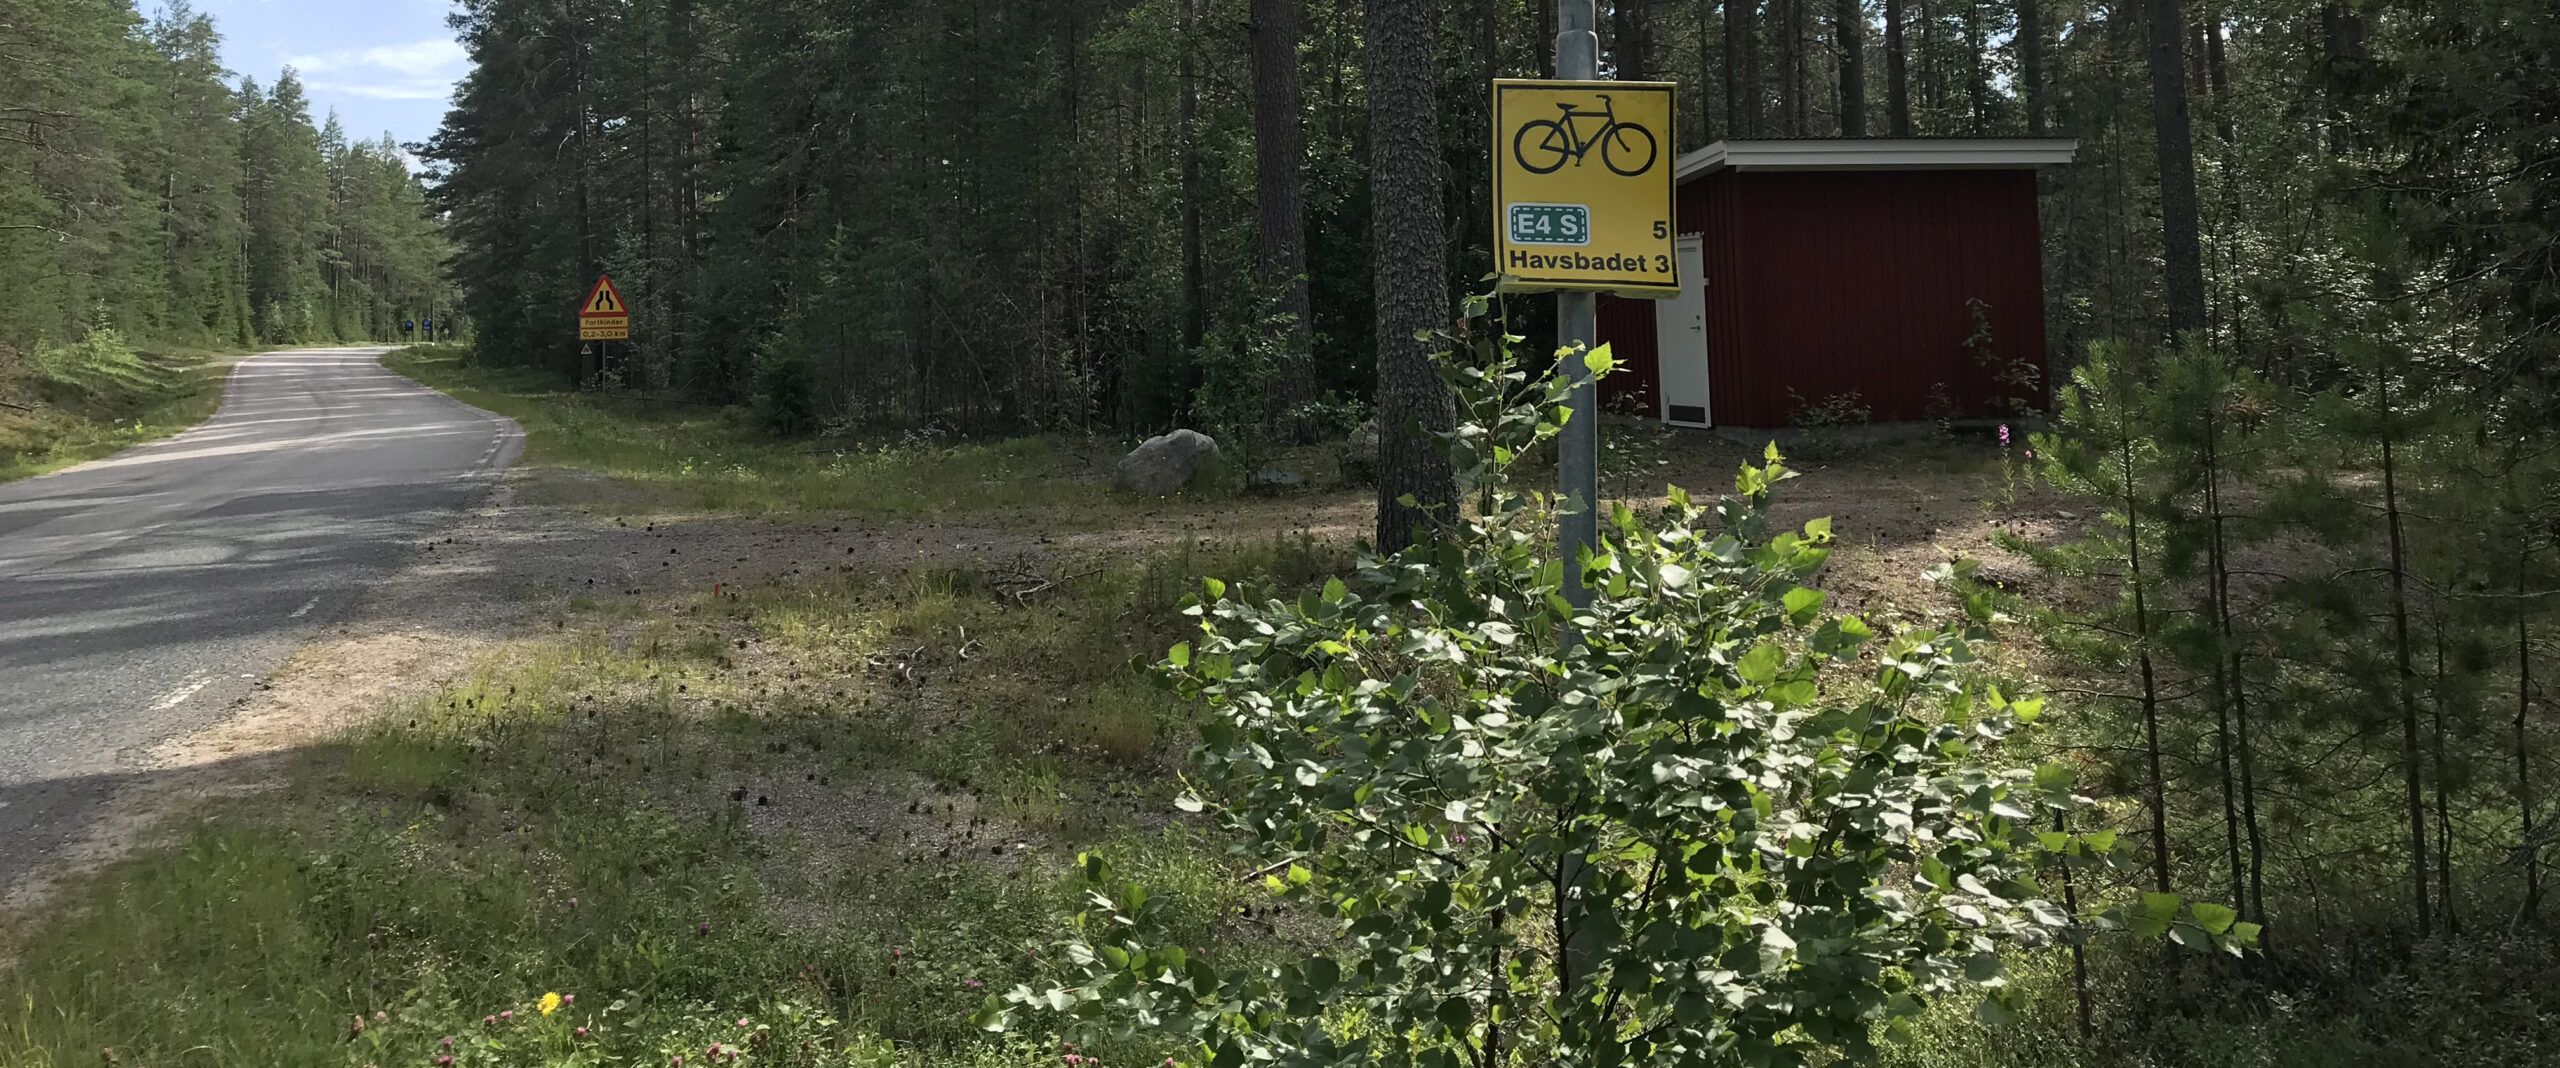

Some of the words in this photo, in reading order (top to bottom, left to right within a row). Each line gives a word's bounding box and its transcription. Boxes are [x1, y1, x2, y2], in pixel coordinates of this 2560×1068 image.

[1517, 213, 1551, 234] E4
[1560, 214, 1578, 235] S
[1652, 220, 1668, 239] 5
[1509, 250, 1647, 272] Havsbadet
[1654, 254, 1670, 273] 3
